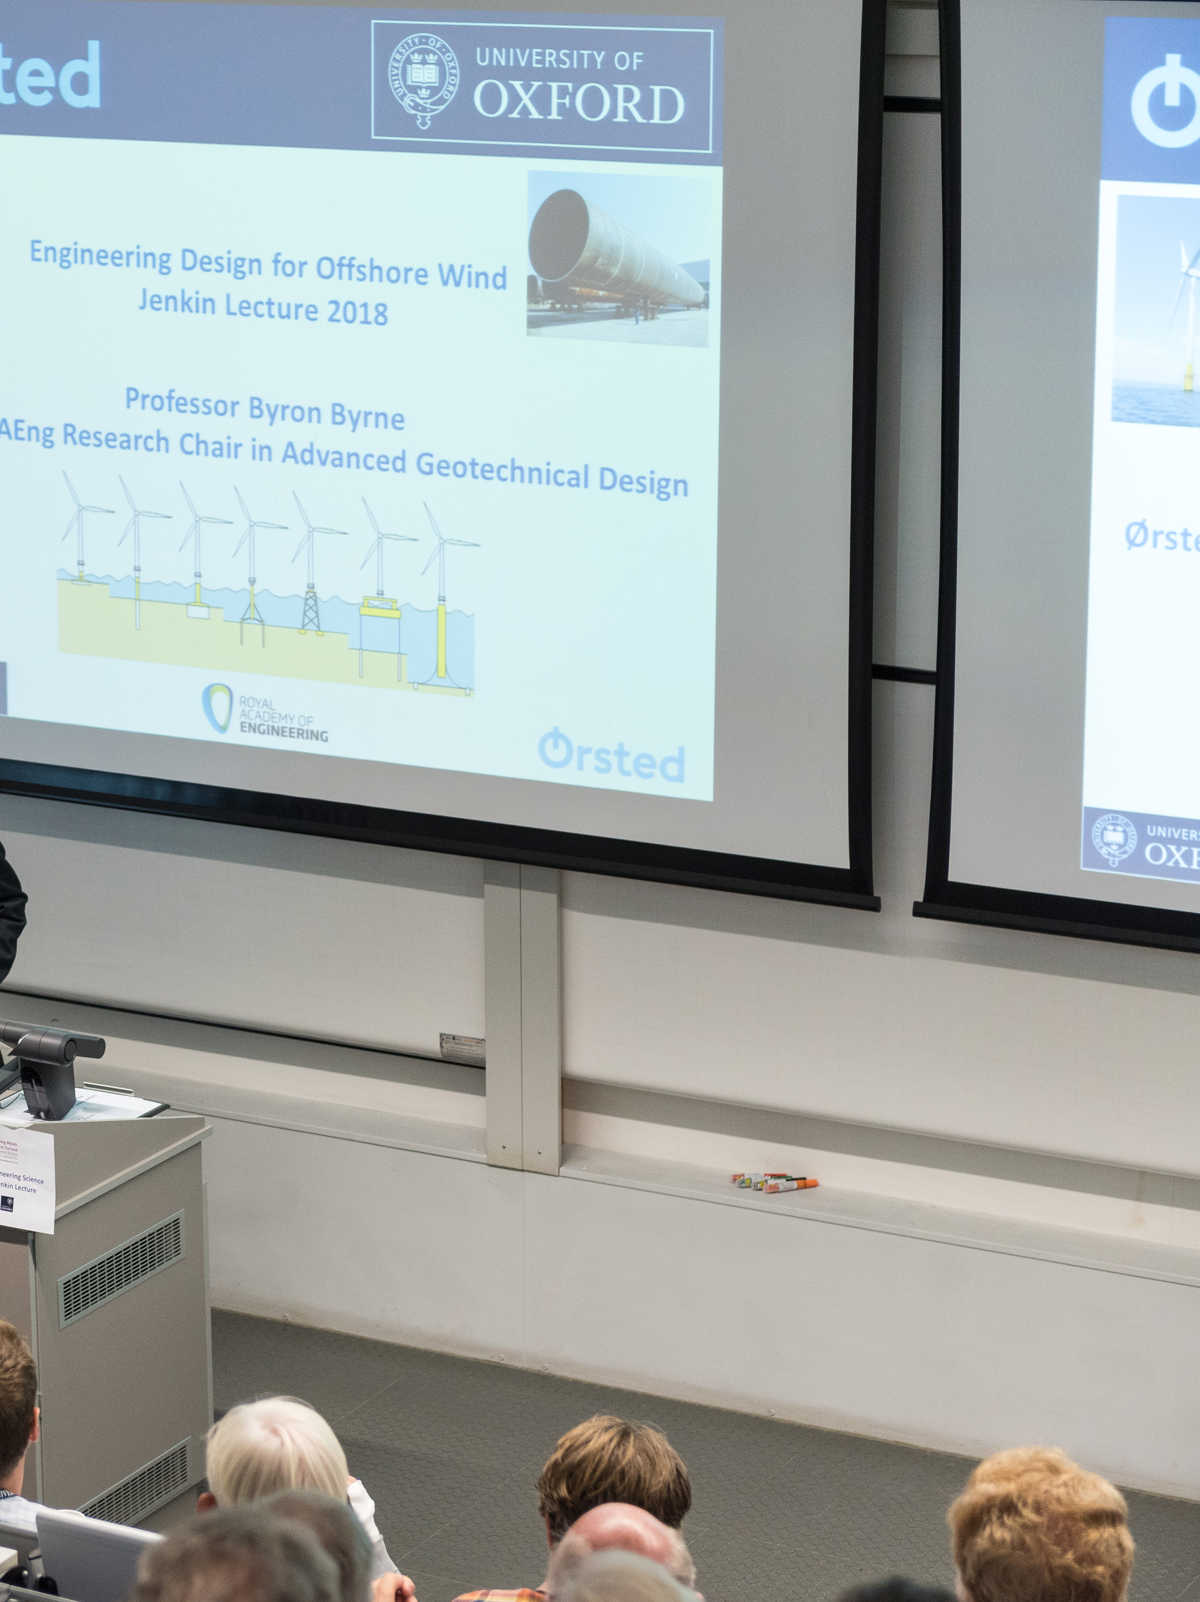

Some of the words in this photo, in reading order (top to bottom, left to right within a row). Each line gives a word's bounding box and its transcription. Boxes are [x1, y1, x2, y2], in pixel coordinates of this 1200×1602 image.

[476, 47, 605, 70] UNIVERSITY
[614, 51, 644, 71] OF
[473, 78, 686, 126] OXFORD
[30, 239, 172, 276] Engineering
[181, 248, 263, 280] Design
[271, 252, 309, 278] for
[316, 256, 430, 286] Offshore
[438, 263, 508, 291] Wind
[138, 287, 216, 315] Jenkin
[225, 293, 319, 322] Lecture
[327, 300, 389, 327] 2018
[125, 386, 240, 418] Professor
[249, 396, 322, 427] Byron
[331, 402, 406, 433] Byrne
[63, 422, 170, 455] Research
[179, 432, 244, 460] Chair
[250, 436, 272, 463] in
[281, 441, 407, 474] Advanced
[416, 451, 590, 490] Geotechnical
[599, 467, 689, 503] Design
[240, 695, 276, 711] ROYAL
[240, 708, 296, 725] ACADEMY
[298, 713, 314, 727] OF
[240, 720, 329, 743] ENGINEERING
[537, 725, 685, 784] Ørsted
[1146, 825, 1200, 842] UNIVER
[14, 1184, 38, 1194] Lecture
[22, 1174, 45, 1186] Science
